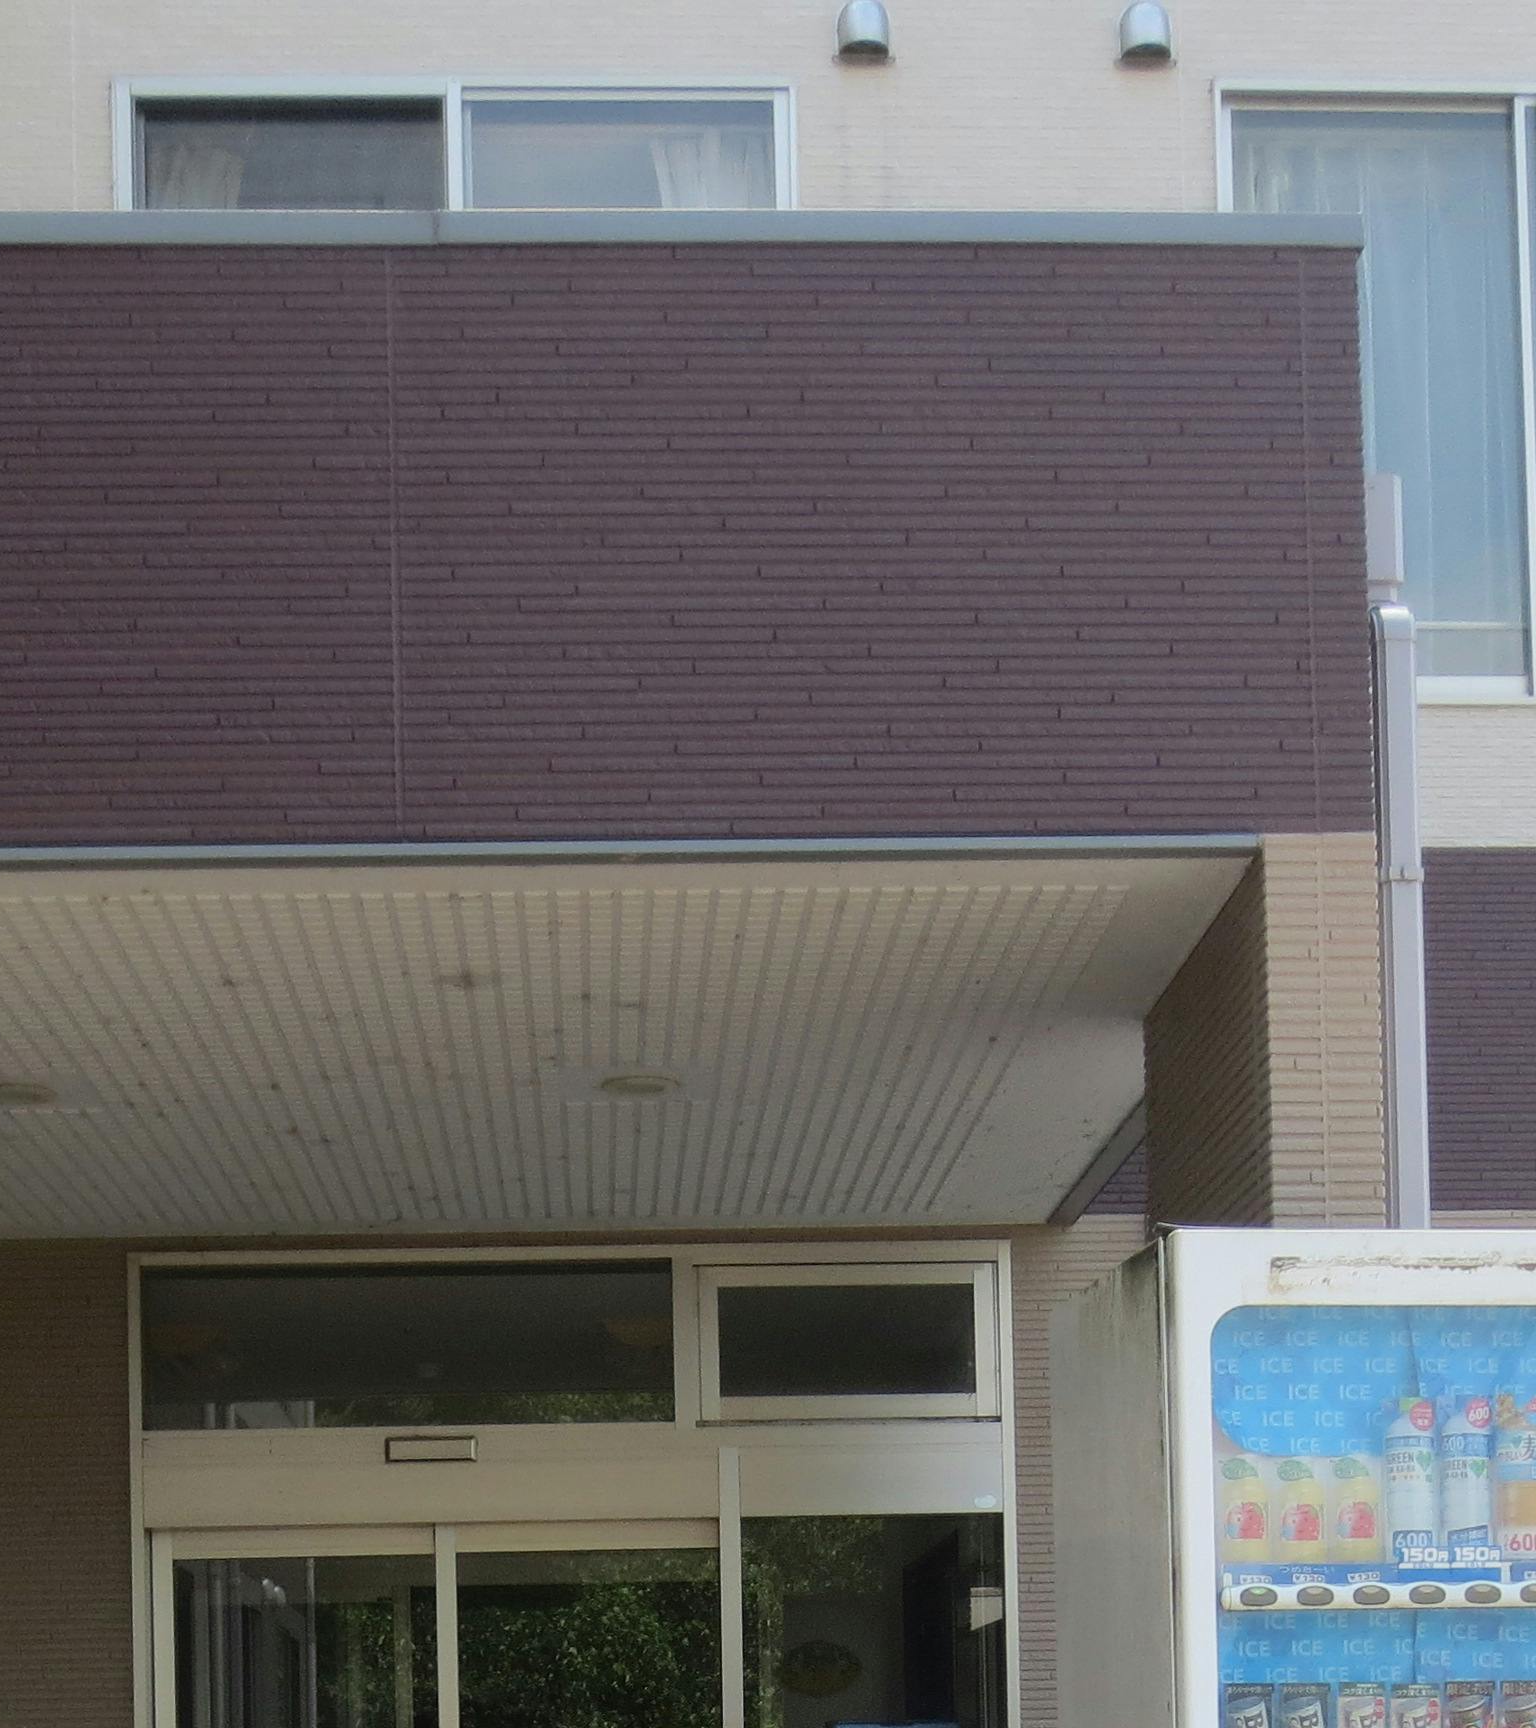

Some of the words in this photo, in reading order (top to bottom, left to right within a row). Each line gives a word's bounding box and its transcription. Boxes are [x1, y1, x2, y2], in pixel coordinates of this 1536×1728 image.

[1214, 1360, 1240, 1375] CE
[1222, 1410, 1242, 1427] CE
[1366, 1411, 1384, 1427] IC
[1468, 1407, 1490, 1421] 600
[1395, 1533, 1428, 1547] 600
[1401, 1547, 1449, 1562] 150円
[1454, 1546, 1501, 1561] 150円
[1395, 1639, 1413, 1656] IC
[1221, 1668, 1244, 1683] CE
